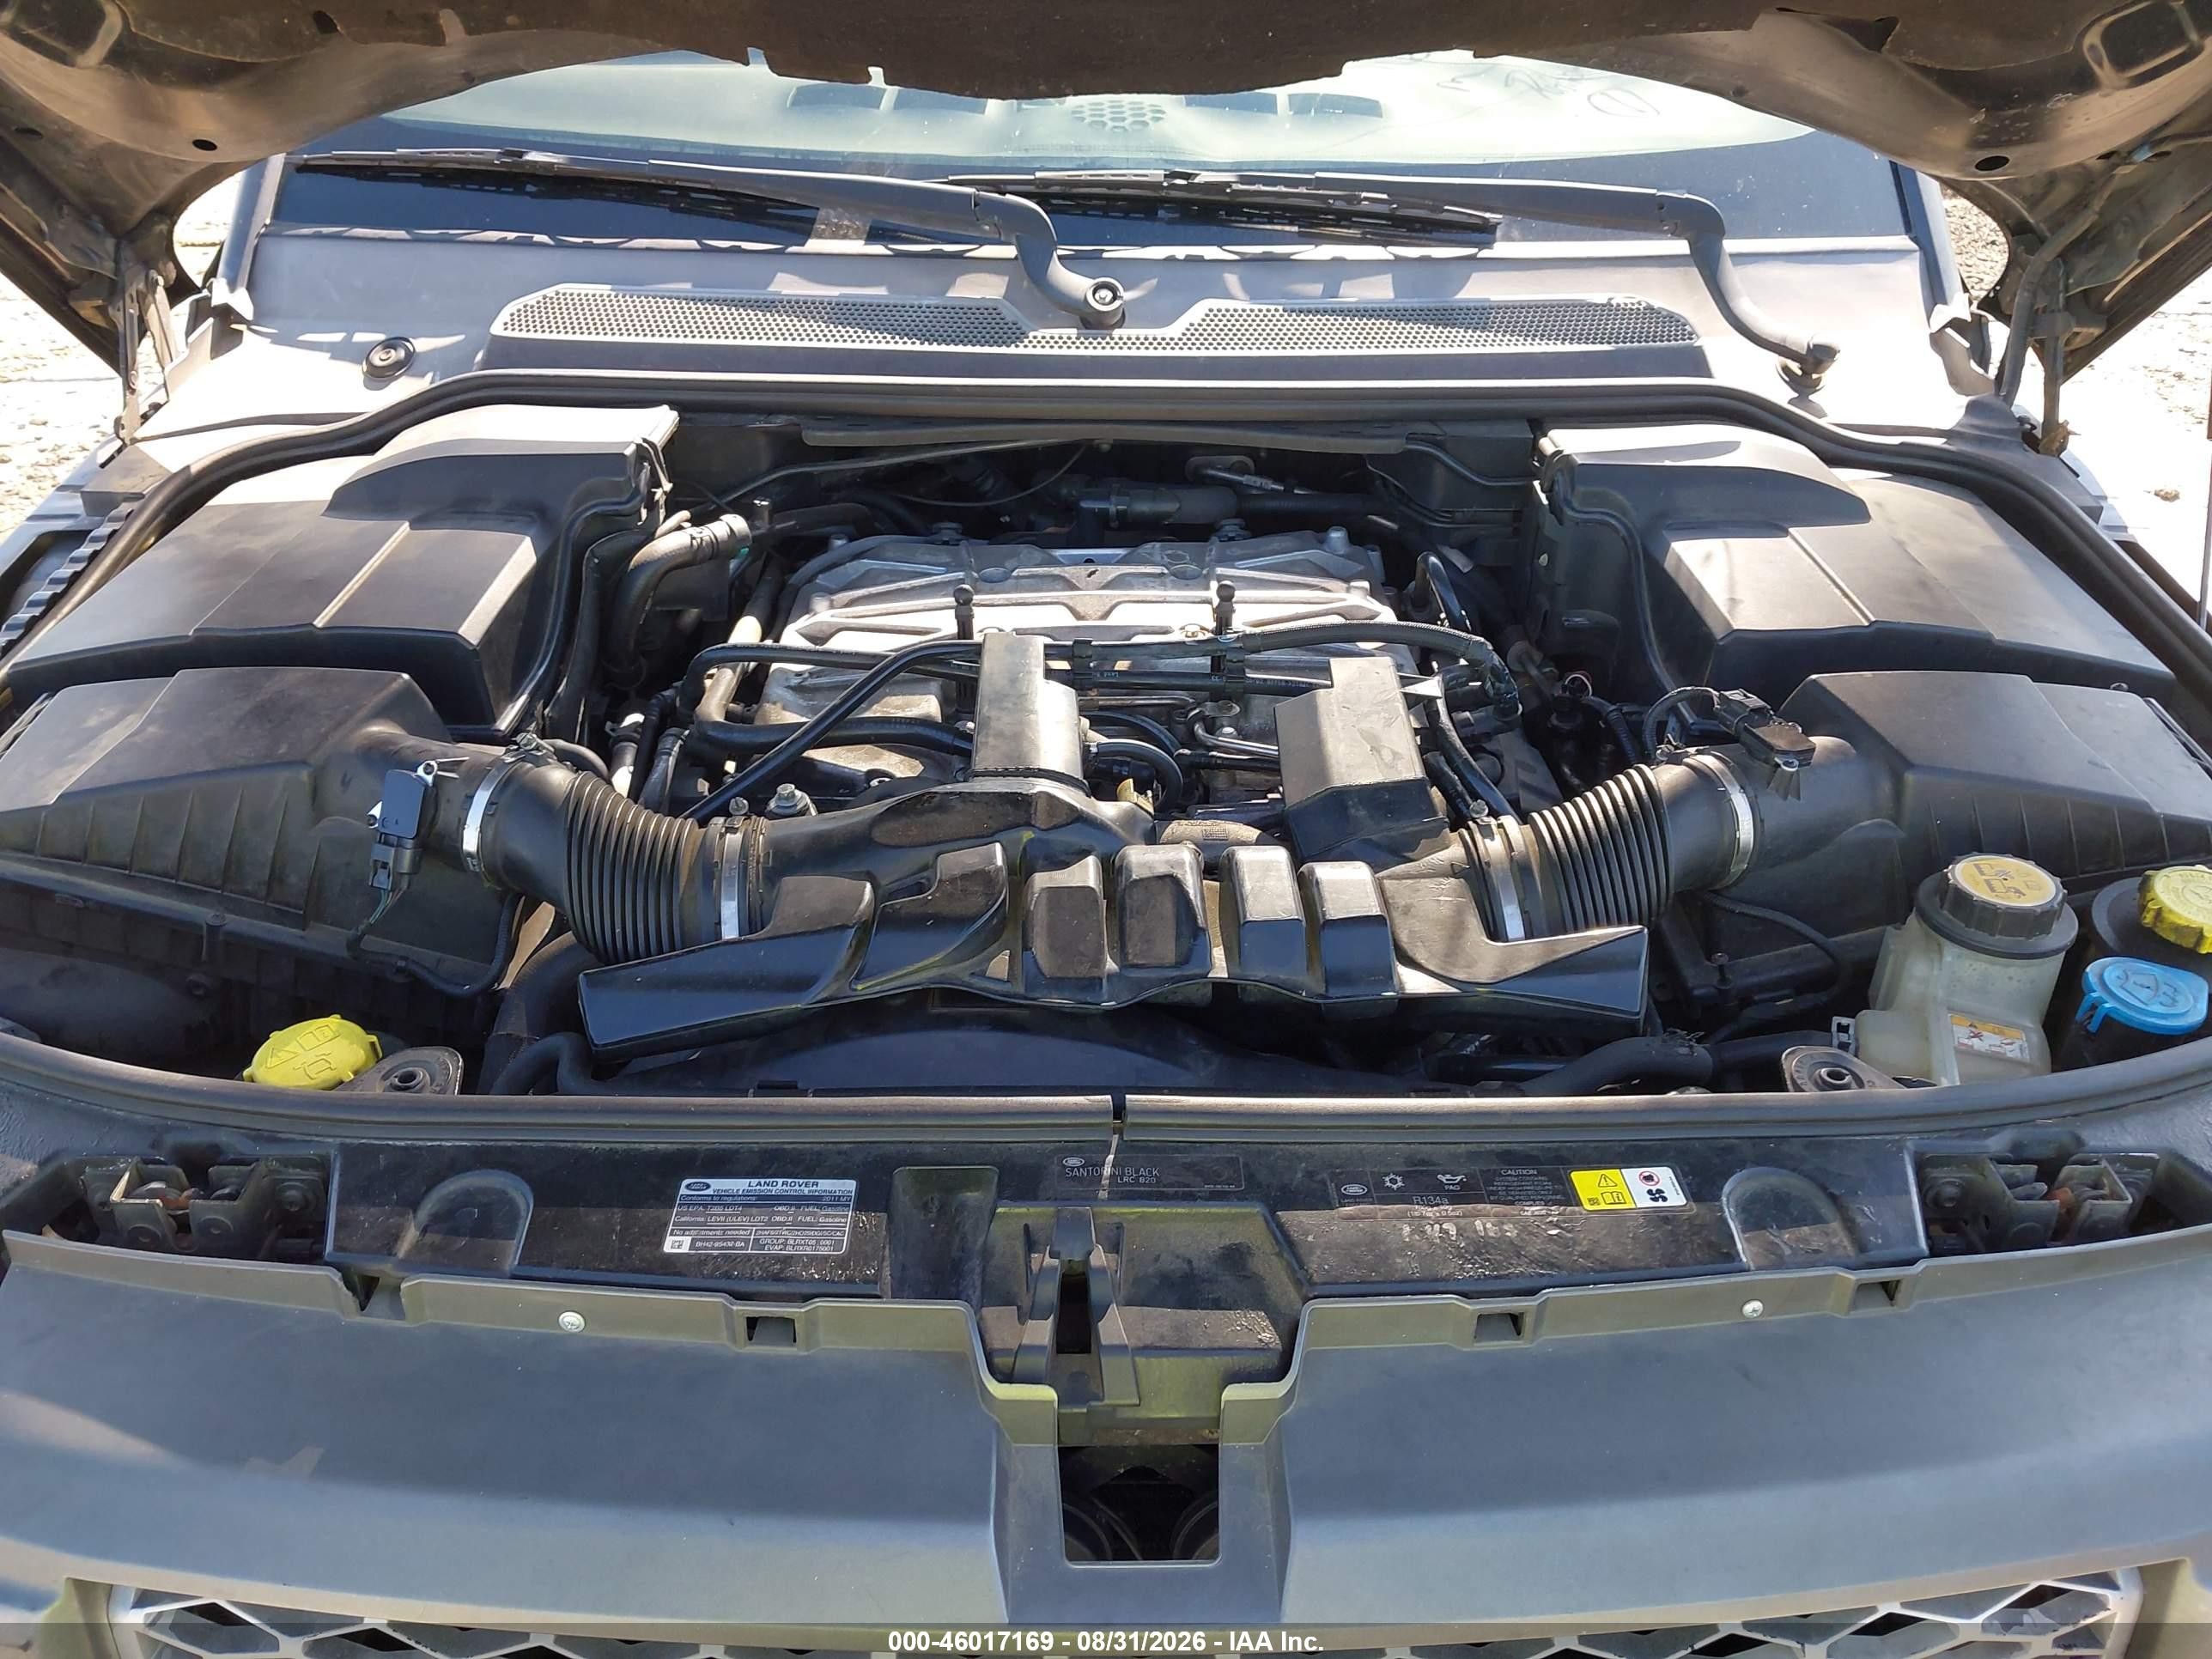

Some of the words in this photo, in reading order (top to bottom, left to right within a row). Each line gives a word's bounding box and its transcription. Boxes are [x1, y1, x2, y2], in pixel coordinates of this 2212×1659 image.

[1125, 1167, 1159, 1177] BLACK
[747, 1180, 779, 1188] LAND
[780, 1180, 819, 1188] ROVER
[1413, 1195, 1449, 1204] R134a
